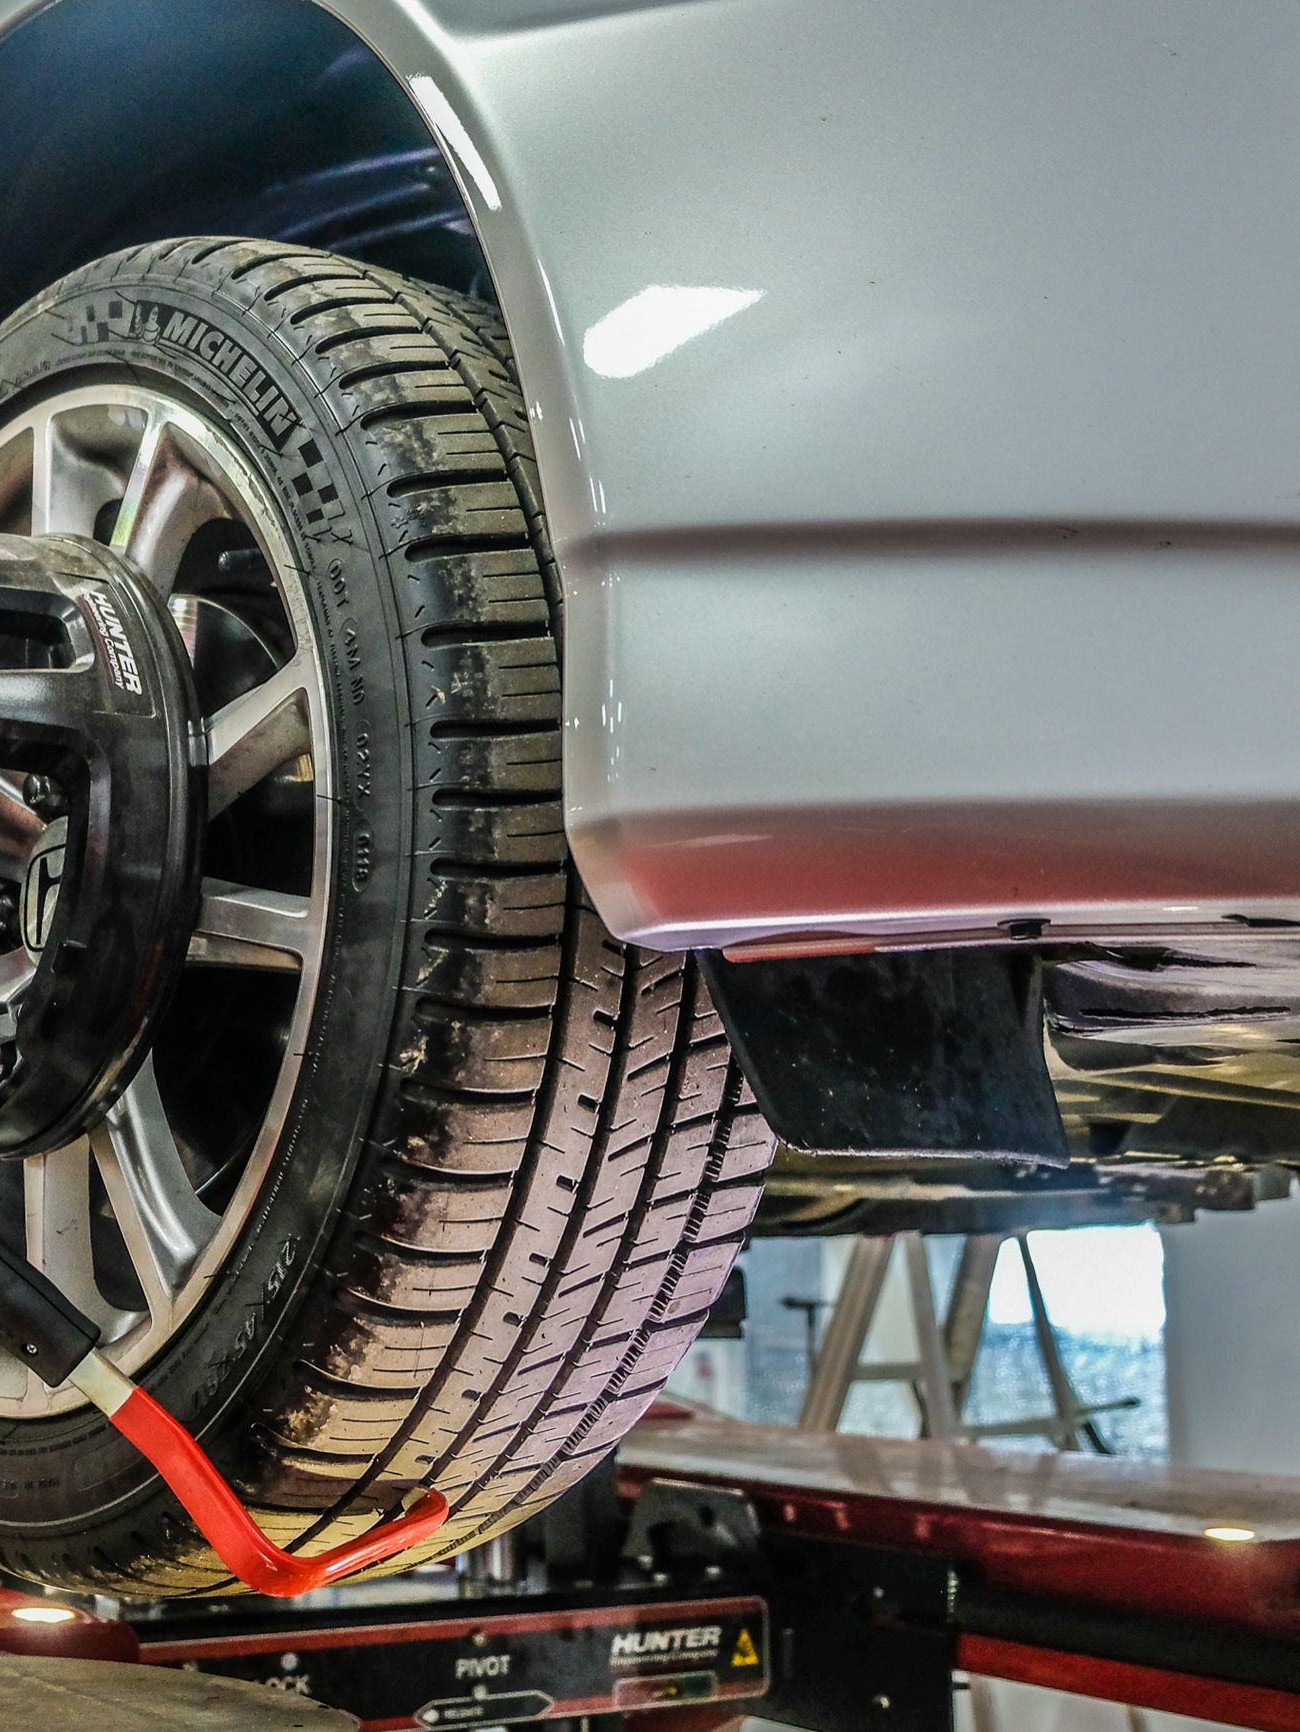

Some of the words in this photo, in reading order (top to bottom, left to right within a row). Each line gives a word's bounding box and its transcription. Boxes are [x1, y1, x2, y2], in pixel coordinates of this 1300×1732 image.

[163, 310, 299, 437] MICHELIN
[89, 590, 143, 695] HUNTER
[104, 637, 125, 690] Company
[610, 1625, 722, 1656] HUNTER
[256, 1674, 310, 1695] OCK
[455, 1654, 511, 1679] PIVOT
